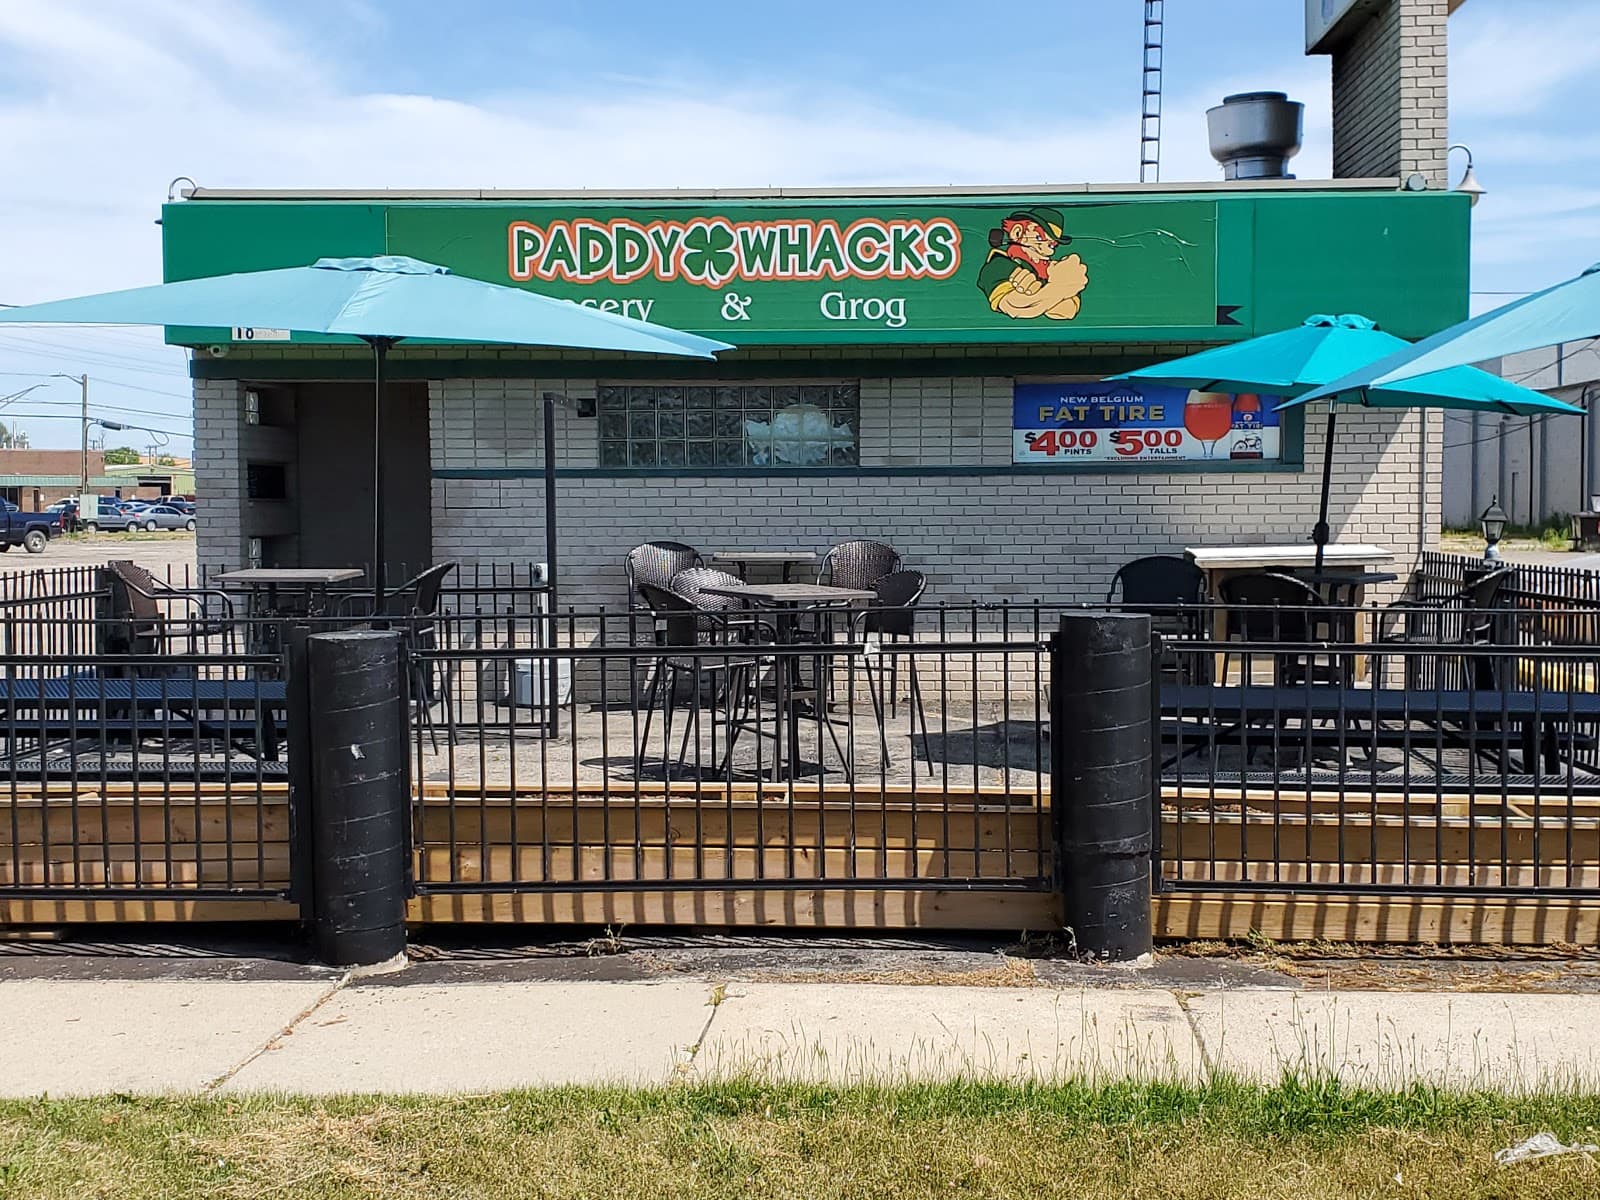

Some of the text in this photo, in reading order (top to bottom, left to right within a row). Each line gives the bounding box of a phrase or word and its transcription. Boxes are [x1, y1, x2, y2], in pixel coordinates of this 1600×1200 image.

[509, 218, 961, 281] PADDY WHACKS
[721, 292, 752, 321] &
[820, 292, 907, 328] Grog
[1039, 405, 1165, 421] FAT TIRE
